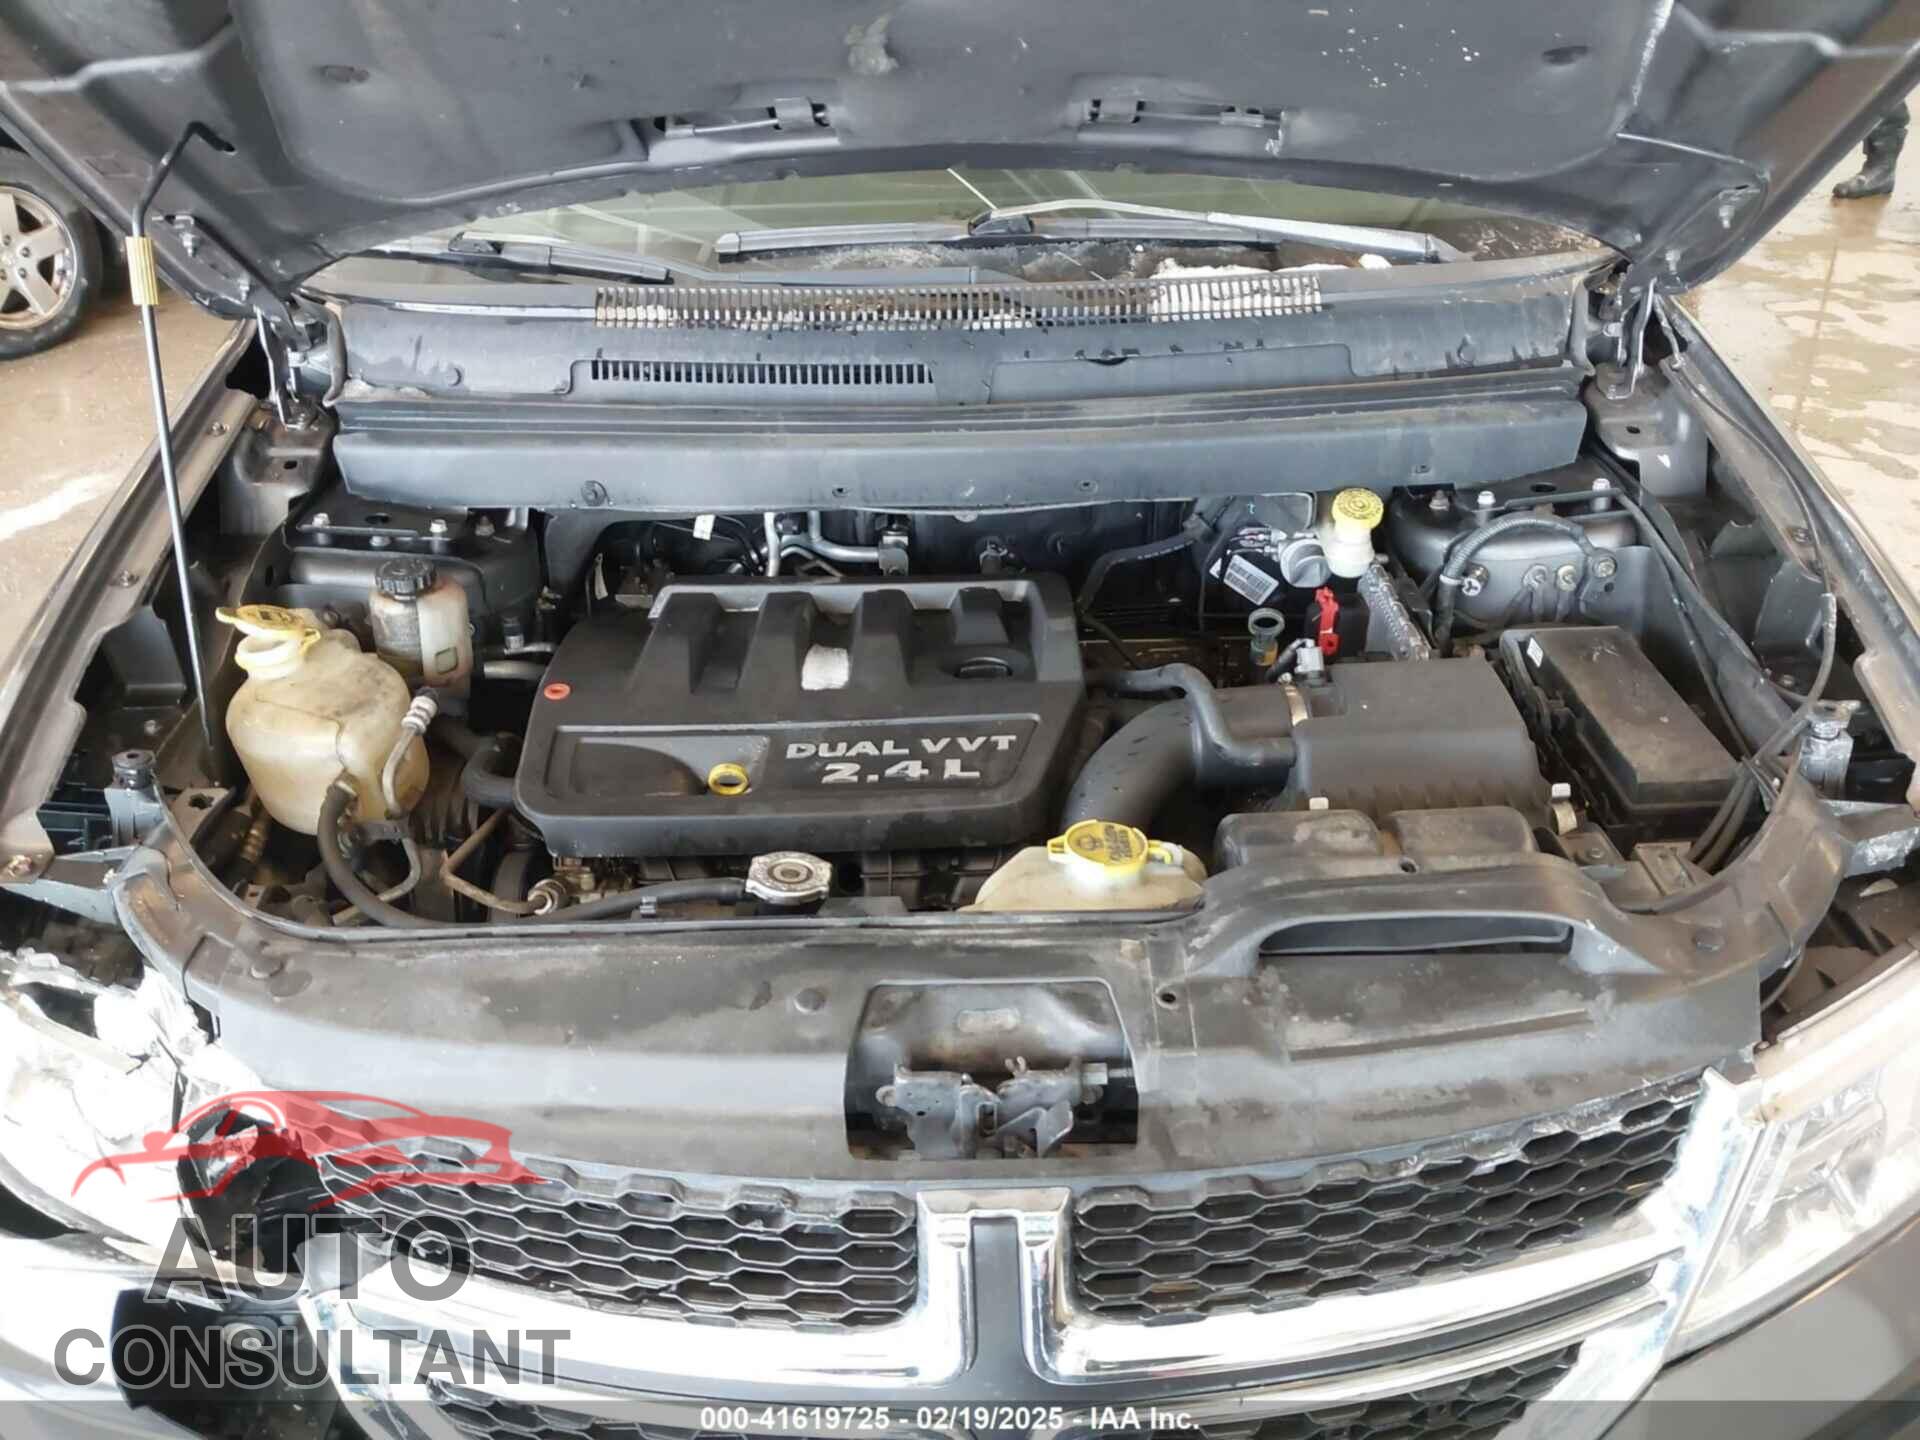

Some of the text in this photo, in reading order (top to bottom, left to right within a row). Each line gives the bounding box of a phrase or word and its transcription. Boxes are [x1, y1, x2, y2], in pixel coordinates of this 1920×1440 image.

[785, 735, 1017, 759] DUAL VVT
[821, 758, 980, 783] 2.4 L
